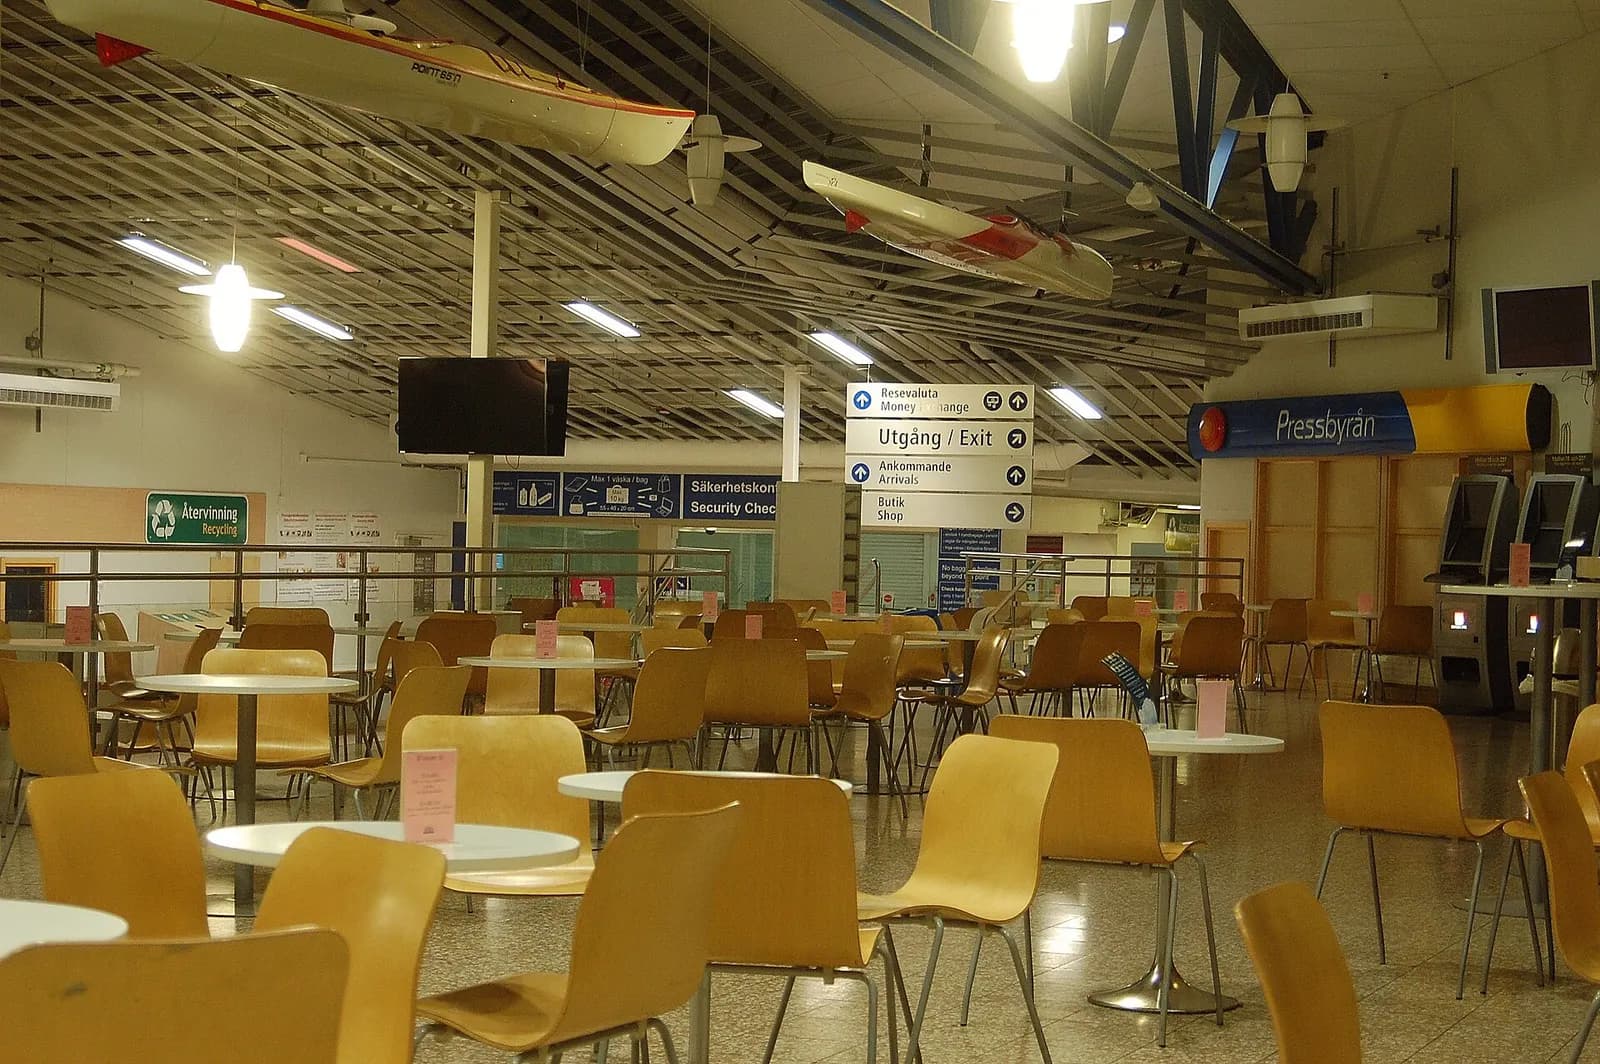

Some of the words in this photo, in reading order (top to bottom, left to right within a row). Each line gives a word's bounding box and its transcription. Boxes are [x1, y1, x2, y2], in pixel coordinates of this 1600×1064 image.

[881, 387, 938, 398] Resevaluta
[880, 401, 916, 414] Money
[1276, 407, 1375, 445] Pressbyrån
[879, 427, 941, 450] Utgång
[948, 429, 954, 446] /
[960, 429, 993, 446] Exit
[879, 460, 952, 472] Ankommande
[878, 473, 919, 485] Arrivals
[691, 480, 777, 493] Säkerhetskon
[878, 496, 905, 507] Butik
[182, 501, 238, 523] Återvinning
[691, 501, 741, 516] Security
[745, 502, 776, 514] Chec
[877, 509, 904, 523] Shop
[202, 522, 238, 537] Recycling
